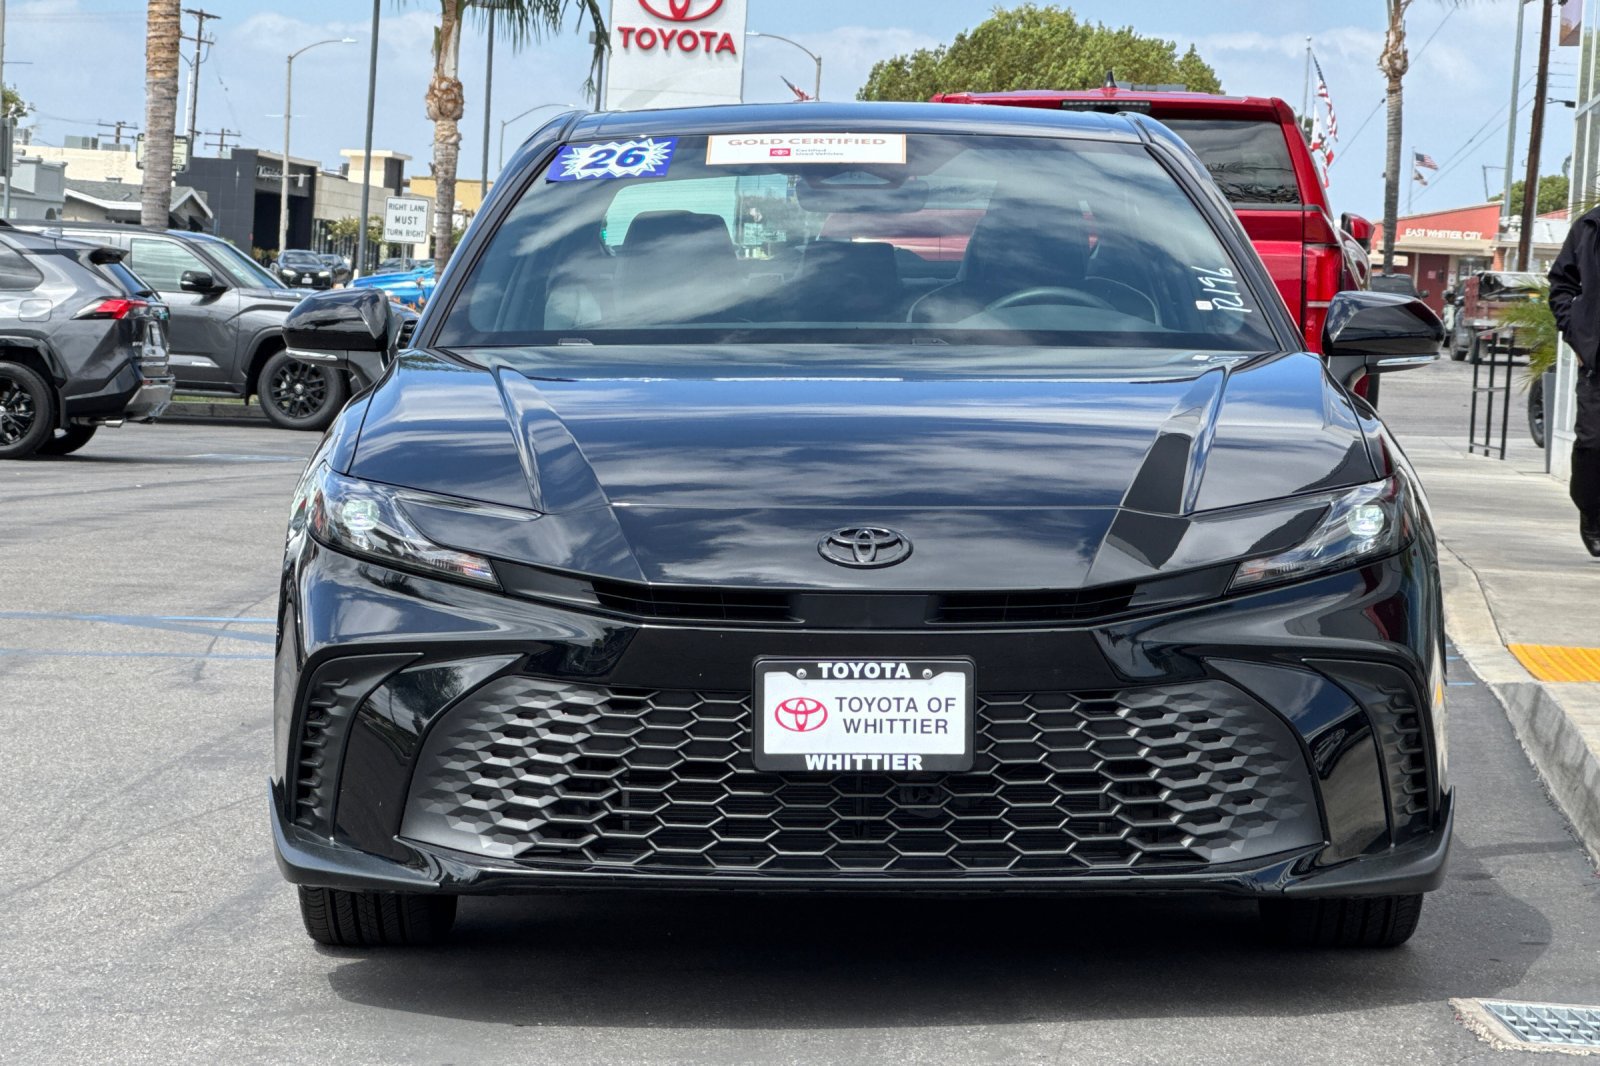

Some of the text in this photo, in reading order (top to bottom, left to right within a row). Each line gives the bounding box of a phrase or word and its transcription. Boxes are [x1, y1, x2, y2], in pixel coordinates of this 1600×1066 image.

[618, 26, 736, 55] TOYOTA
[728, 138, 887, 146] GOLD CERTIFIED
[580, 146, 650, 170] 26
[388, 203, 425, 212] RIGHT LANE
[395, 216, 418, 225] MUST
[387, 228, 424, 238] TURN RIGHT
[1405, 228, 1482, 240] EAST WHITTIER CITY
[817, 662, 911, 679] TOYOTA
[835, 697, 956, 713] TOYOTA OF
[843, 718, 948, 734] WHITTIER
[805, 754, 923, 771] WHITTIER
